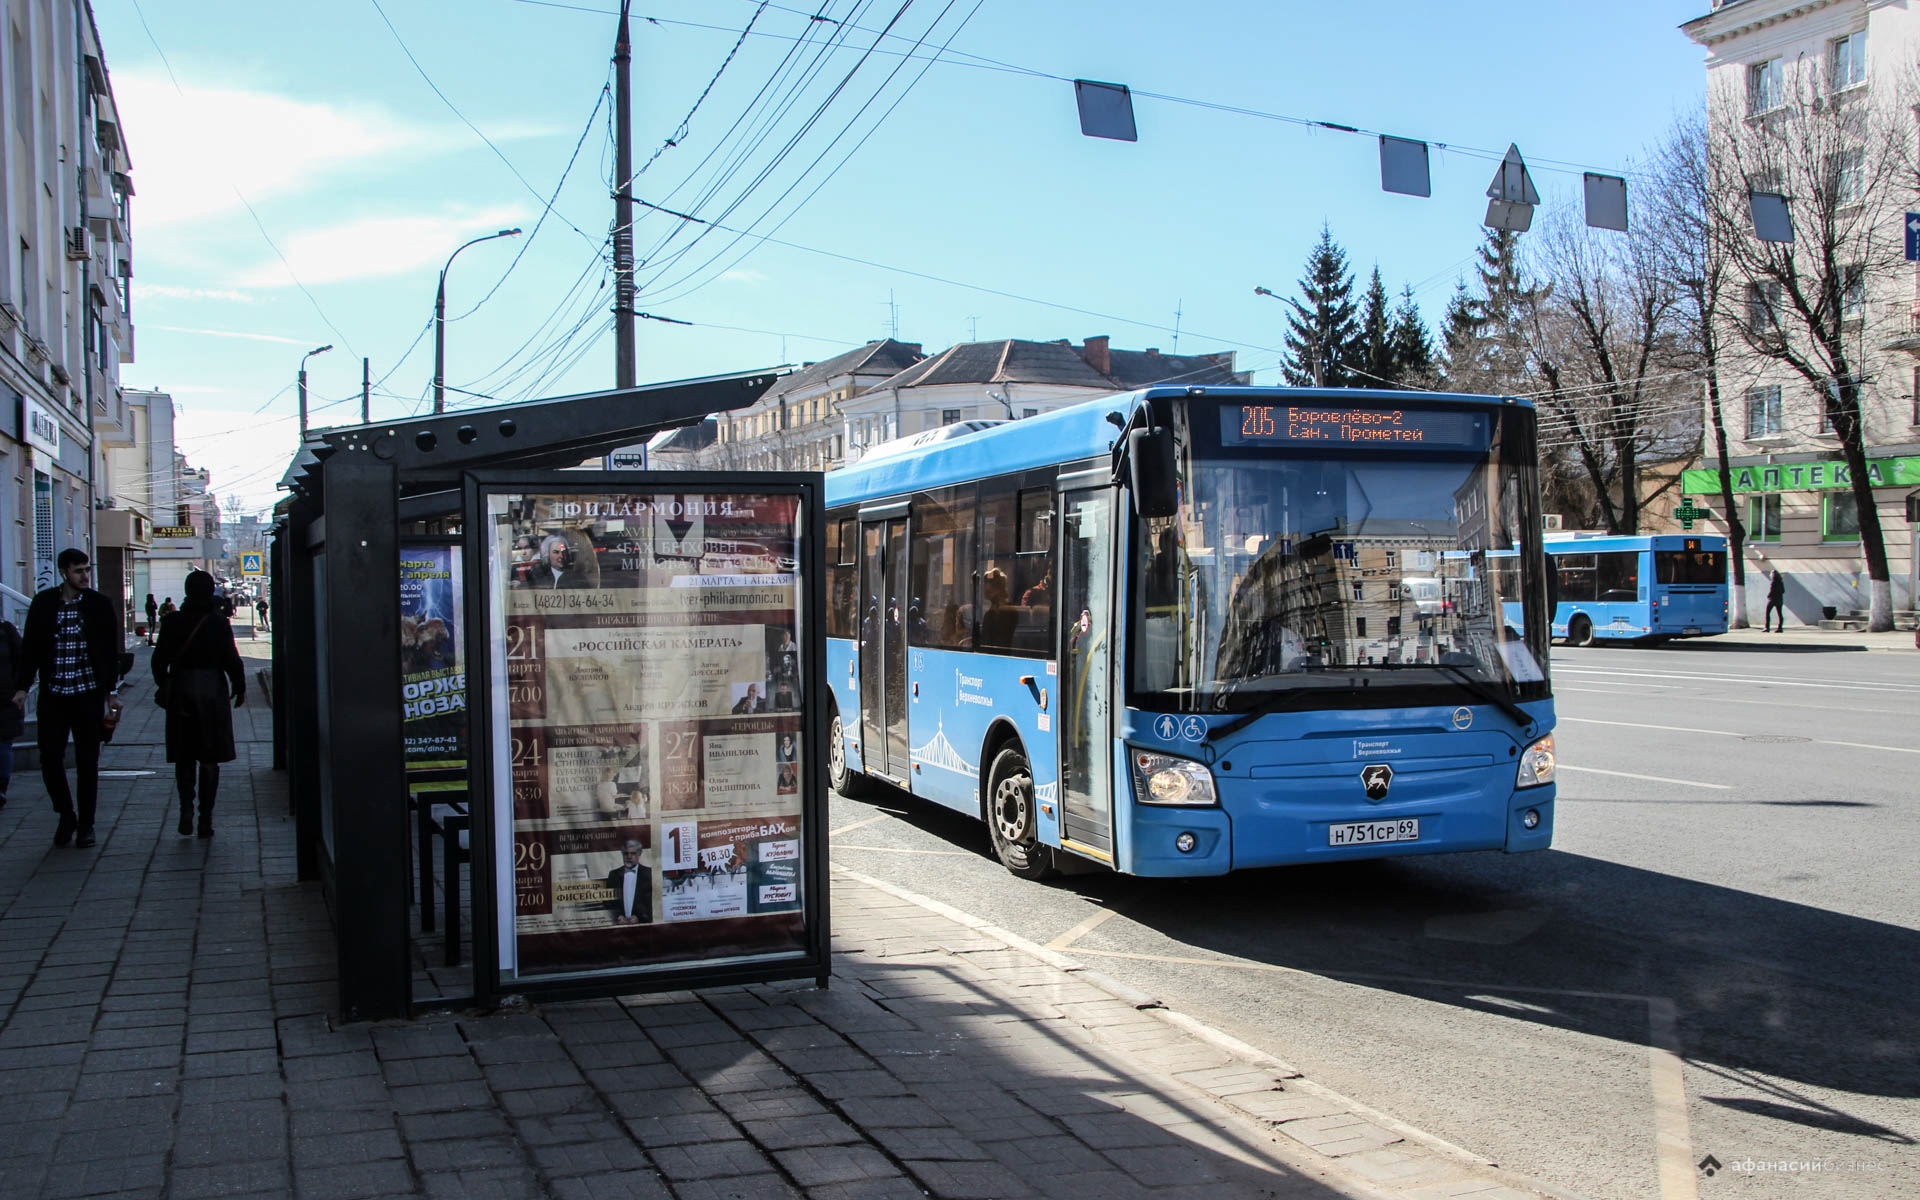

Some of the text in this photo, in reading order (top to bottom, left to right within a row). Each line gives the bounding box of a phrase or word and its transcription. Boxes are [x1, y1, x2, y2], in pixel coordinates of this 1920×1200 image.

[1241, 406, 1403, 436] 205 Боровлёво-2
[1288, 423, 1424, 442] Сан. Прометей
[1738, 463, 1884, 489] АПТЕКА
[564, 501, 734, 517] ФИЛАРМОНИЯ
[407, 570, 450, 580] апреля
[701, 576, 735, 586] МАРТА
[534, 594, 566, 609] (4822)
[568, 594, 614, 608] 34-64-34
[506, 625, 539, 660] 21
[671, 637, 744, 650] КАМЕРАТА»
[403, 693, 466, 720] НОЗА
[511, 738, 543, 768] 24
[665, 731, 698, 761] 27
[700, 824, 759, 840] композиторы
[1335, 820, 1414, 843] Н751СР 69
[668, 827, 682, 865] 1
[682, 826, 695, 863] апреля
[706, 848, 732, 863] 18.30
[514, 842, 546, 872] 29
